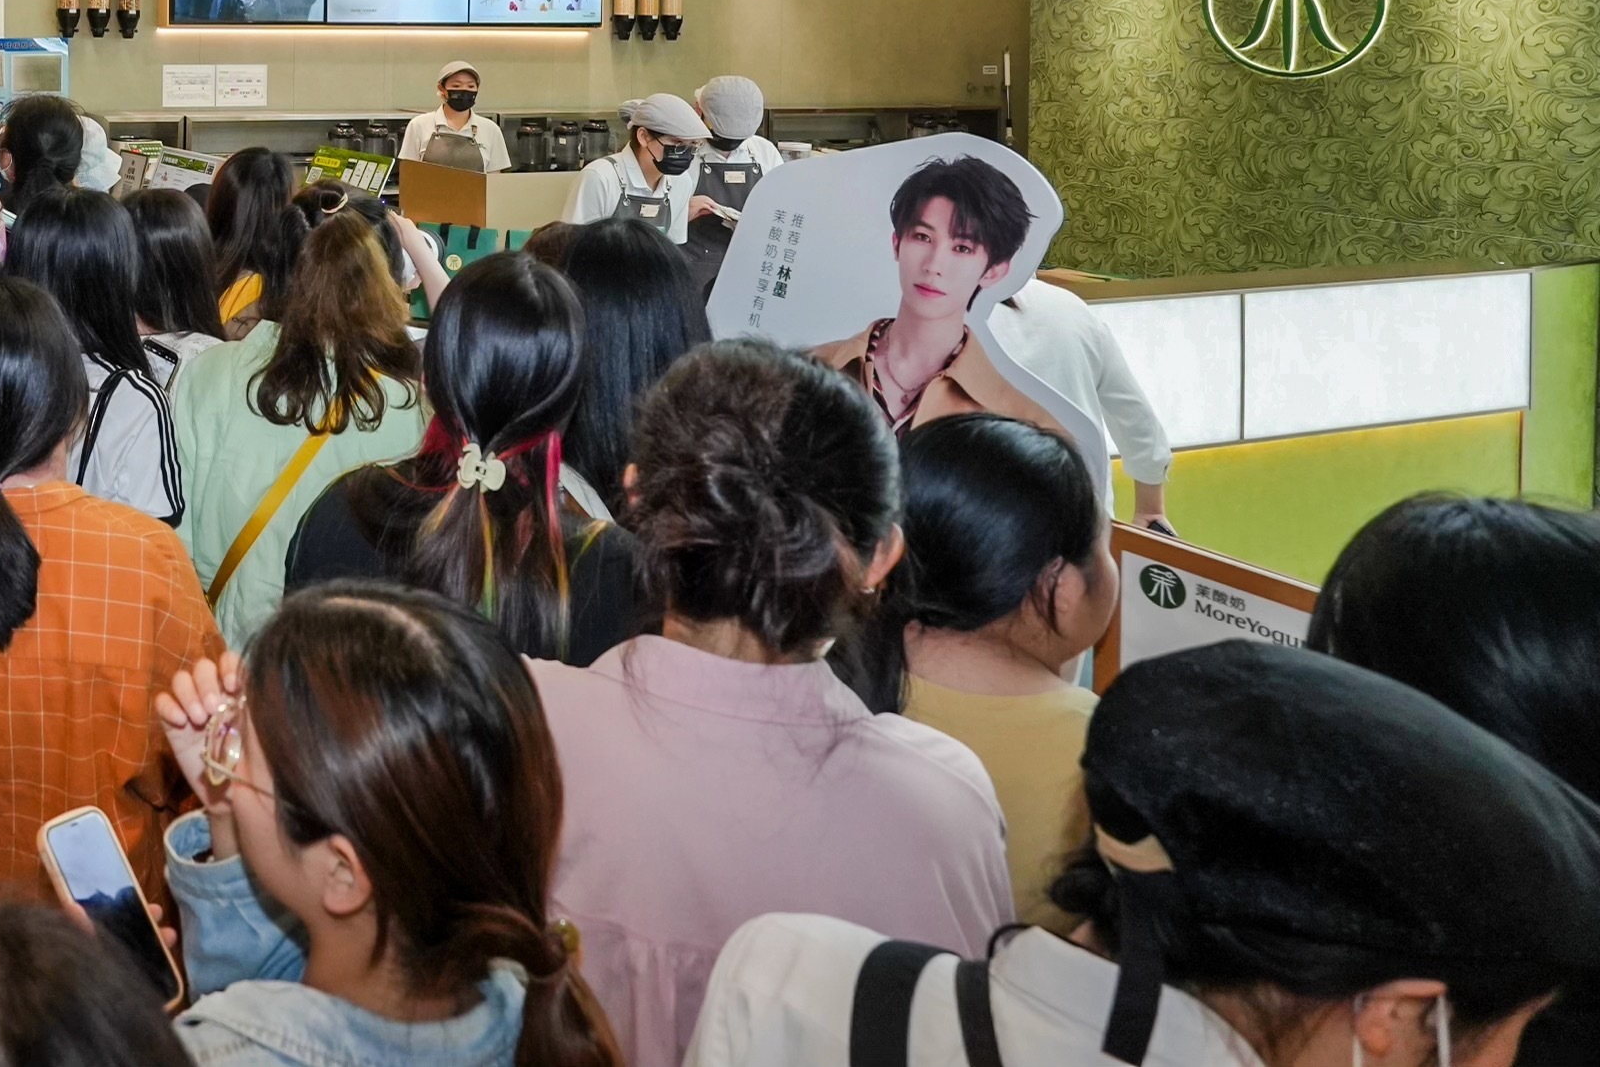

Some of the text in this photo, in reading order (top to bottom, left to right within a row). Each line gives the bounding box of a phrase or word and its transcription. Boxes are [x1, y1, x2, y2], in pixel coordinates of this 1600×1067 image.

[748, 209, 788, 328] 茉酸奶轻享有机
[1195, 584, 1246, 611] 茉酸奶
